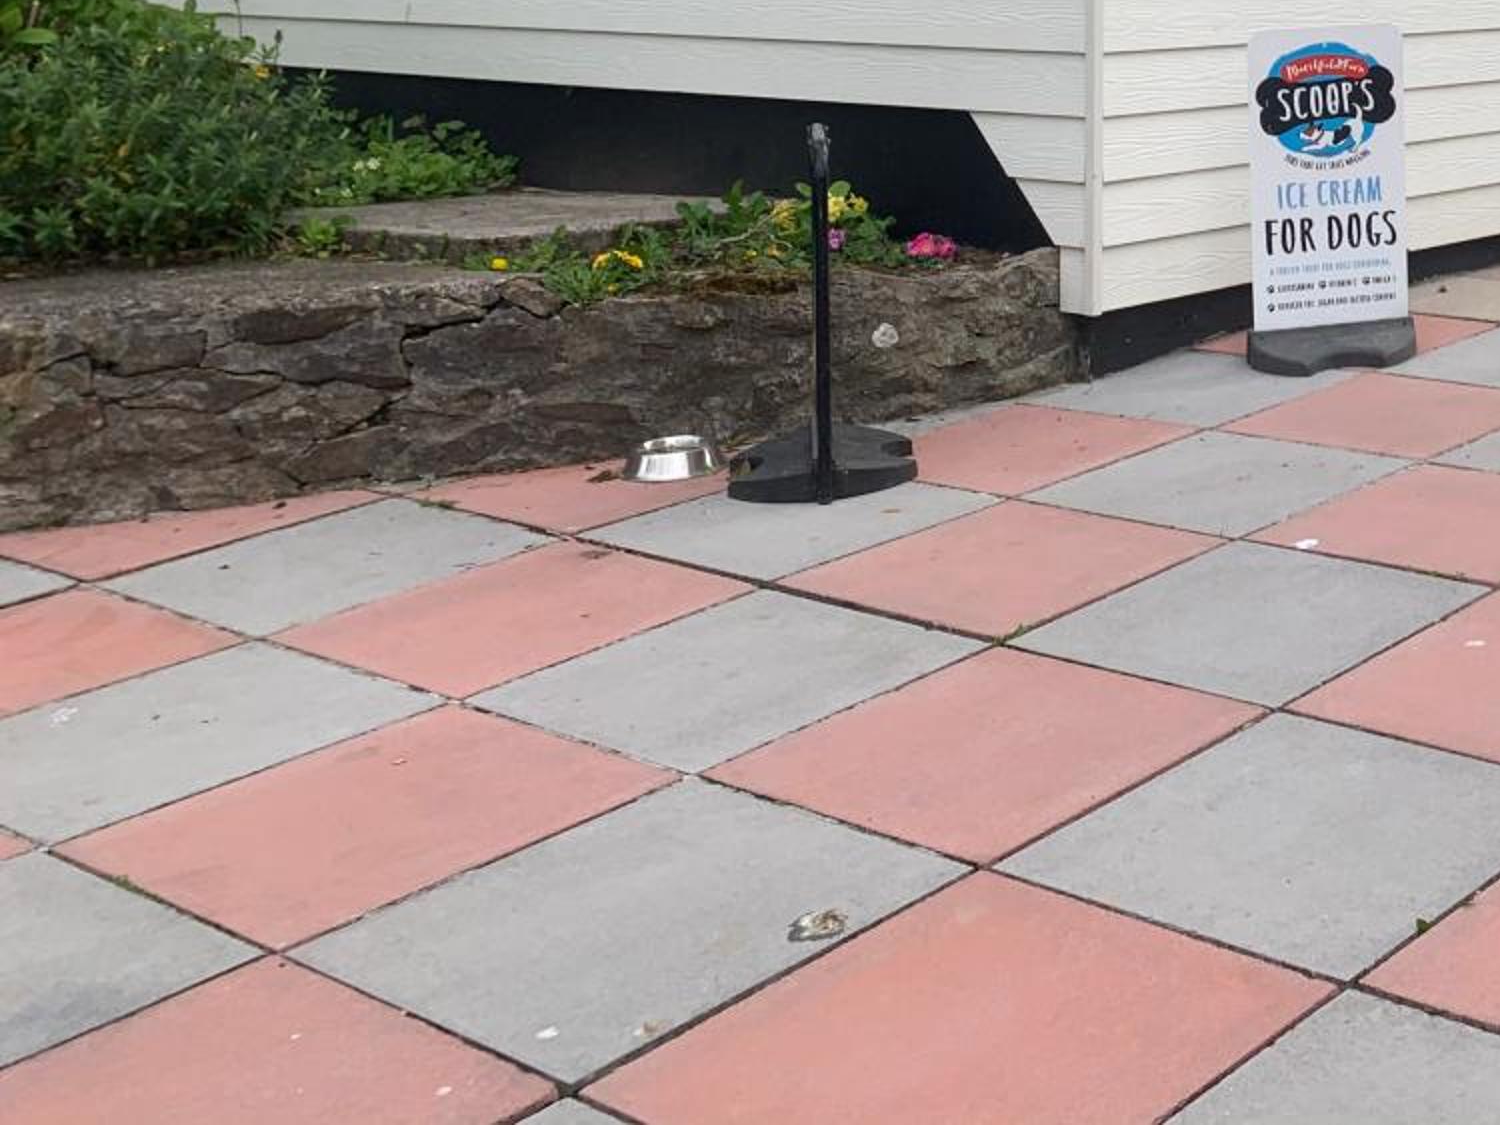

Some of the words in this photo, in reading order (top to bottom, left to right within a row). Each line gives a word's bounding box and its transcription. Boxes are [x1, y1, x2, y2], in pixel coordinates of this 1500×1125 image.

[1277, 79, 1375, 122] SCOOP'S
[1277, 182, 1309, 210] ICE
[1317, 175, 1382, 206] CREAM
[1264, 218, 1317, 256] FOR
[1326, 210, 1397, 250] DOGS
